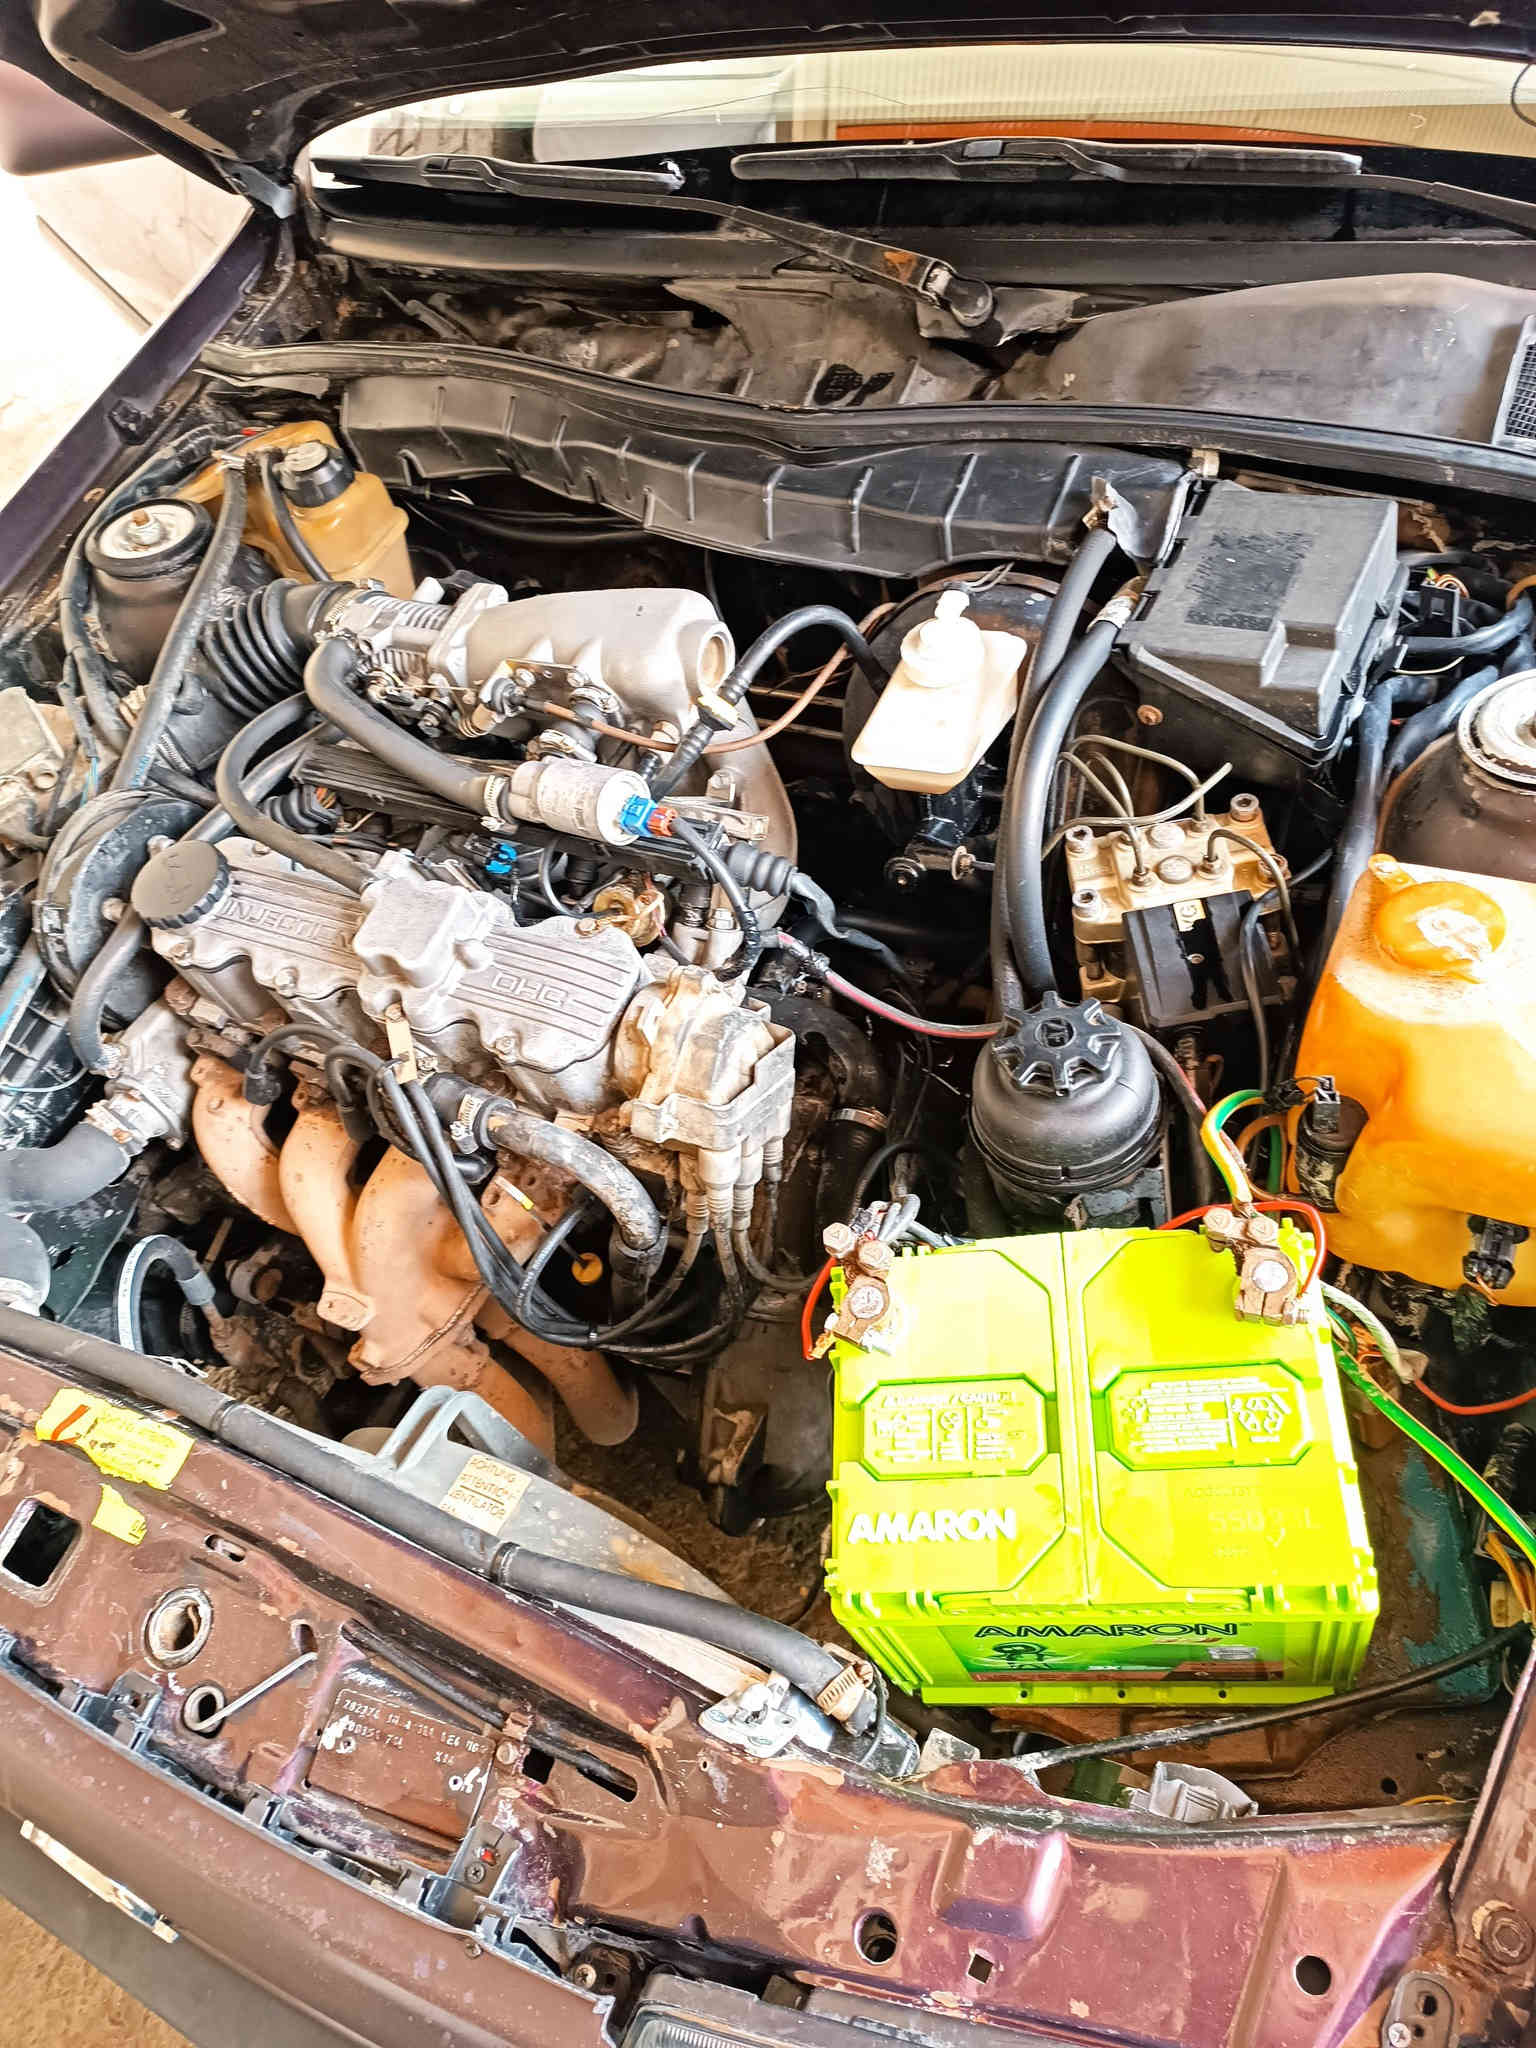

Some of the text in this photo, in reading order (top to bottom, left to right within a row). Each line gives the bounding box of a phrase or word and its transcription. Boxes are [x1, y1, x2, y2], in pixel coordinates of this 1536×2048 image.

[489, 971, 569, 1009] OHC
[847, 1508, 1017, 1544] AMARON
[974, 1622, 1238, 1638] AMARON
